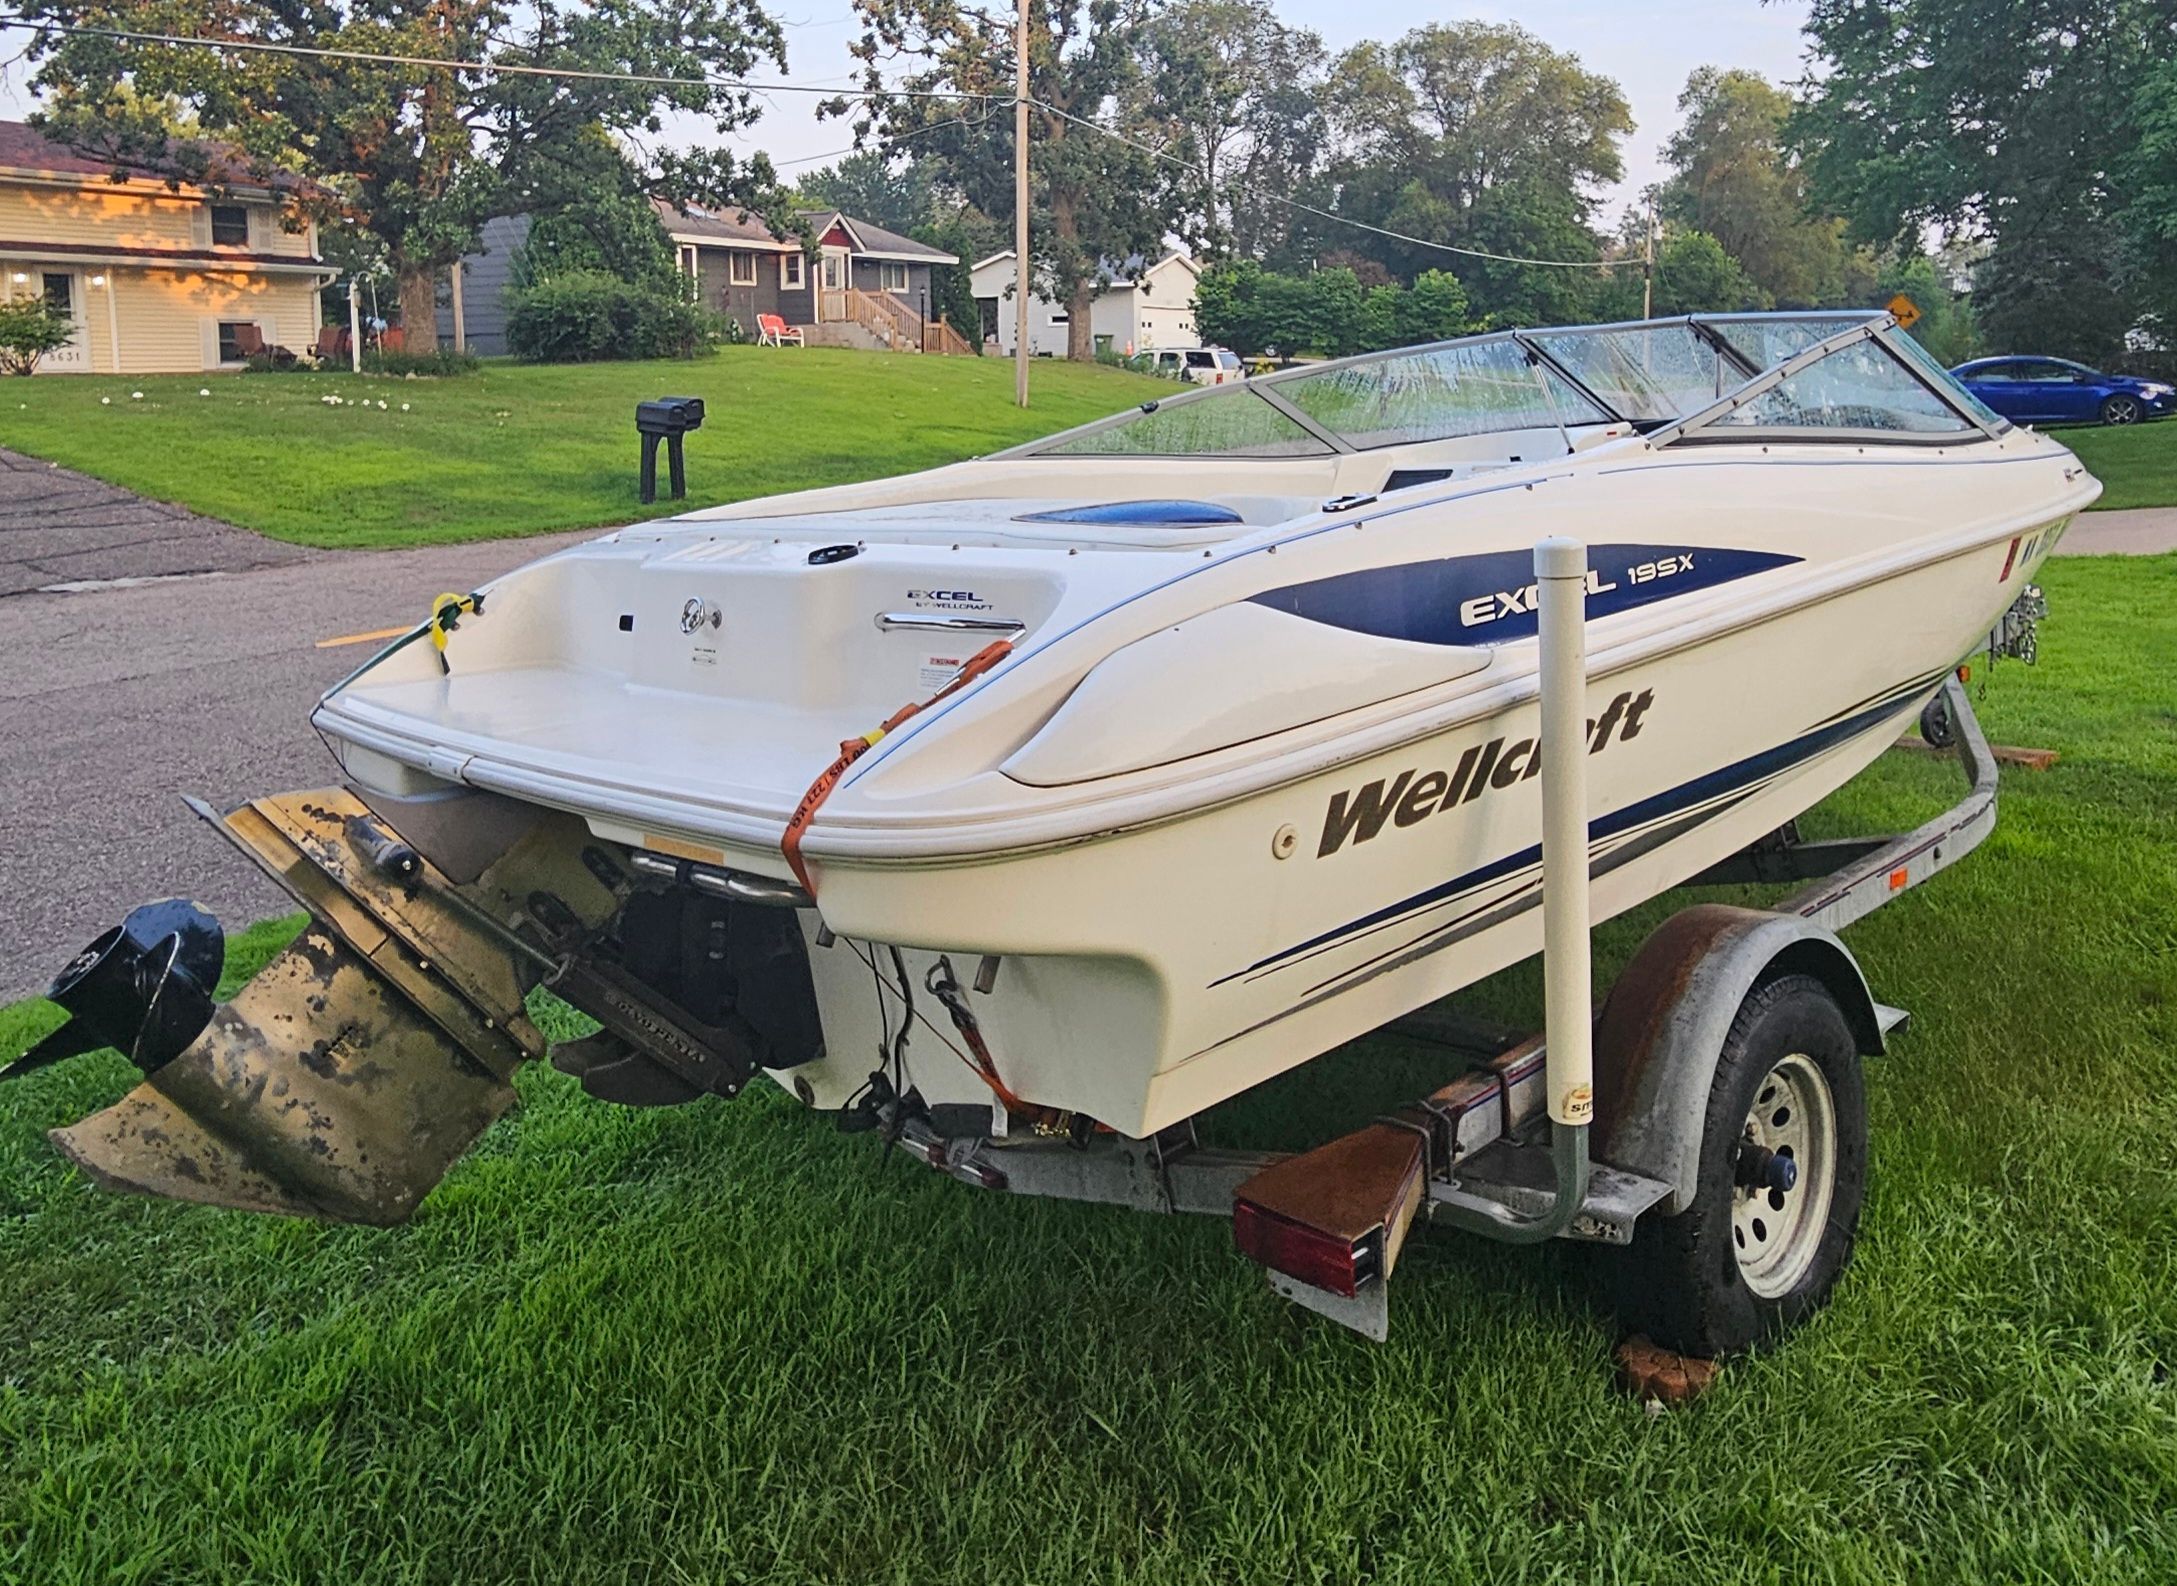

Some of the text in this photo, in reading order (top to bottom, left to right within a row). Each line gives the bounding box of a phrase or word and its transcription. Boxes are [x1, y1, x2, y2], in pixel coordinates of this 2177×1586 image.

[907, 590, 983, 602] EXCEL
[1460, 552, 1695, 628] EXL 19SX
[934, 602, 993, 611] WELLCRAFT
[1316, 687, 1655, 859] Wellcft
[806, 783, 826, 805] 227
